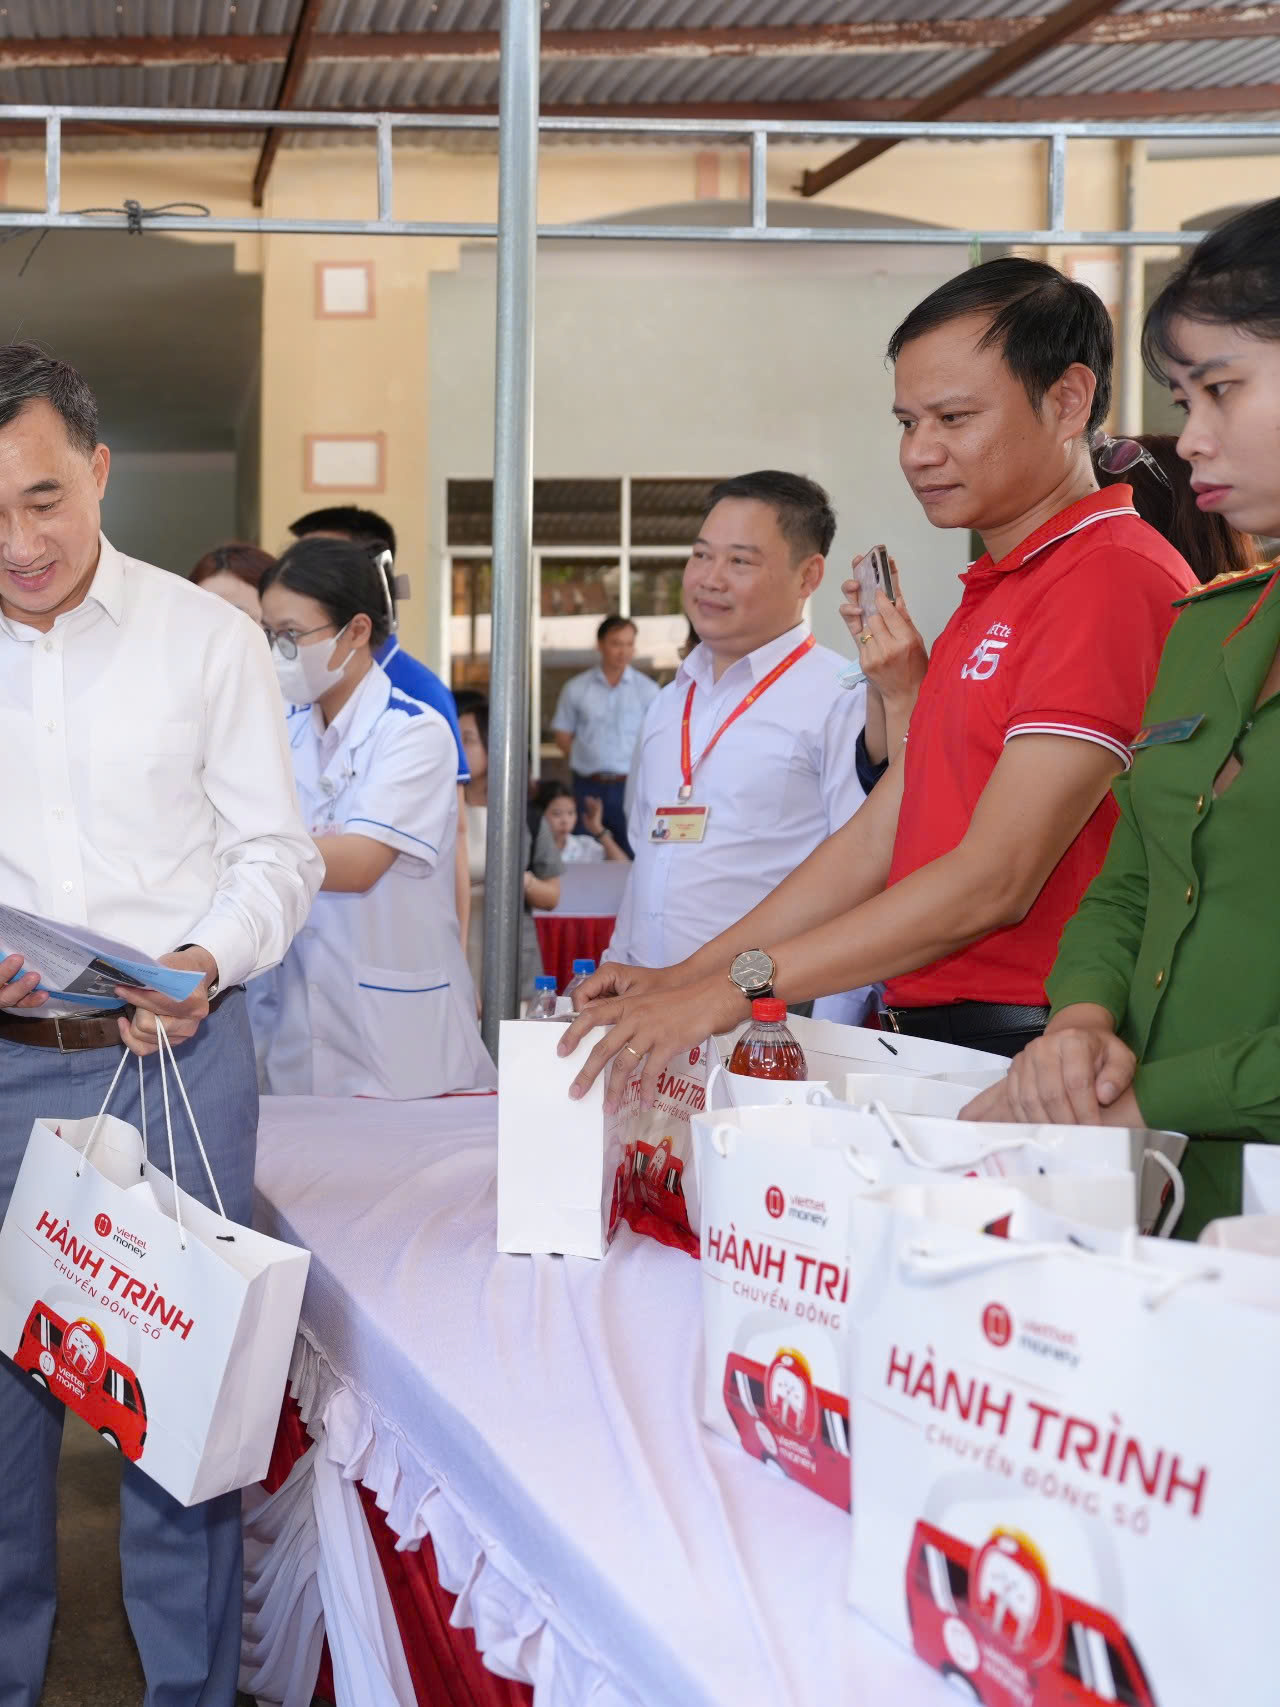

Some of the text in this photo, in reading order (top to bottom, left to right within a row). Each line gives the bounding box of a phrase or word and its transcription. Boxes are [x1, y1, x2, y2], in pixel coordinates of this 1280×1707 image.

[788, 1206, 829, 1228] money
[112, 1233, 147, 1259] money
[116, 1225, 148, 1250] viettel
[707, 1223, 788, 1284] HÀNH
[35, 1210, 195, 1341] HÀNH TRÌNH
[53, 1257, 163, 1341] CHUYỂN ĐỘNG SỐ
[56, 1373, 86, 1400] money
[59, 1365, 86, 1391] viettel
[886, 1343, 1211, 1519] HÀNH TRÌNH
